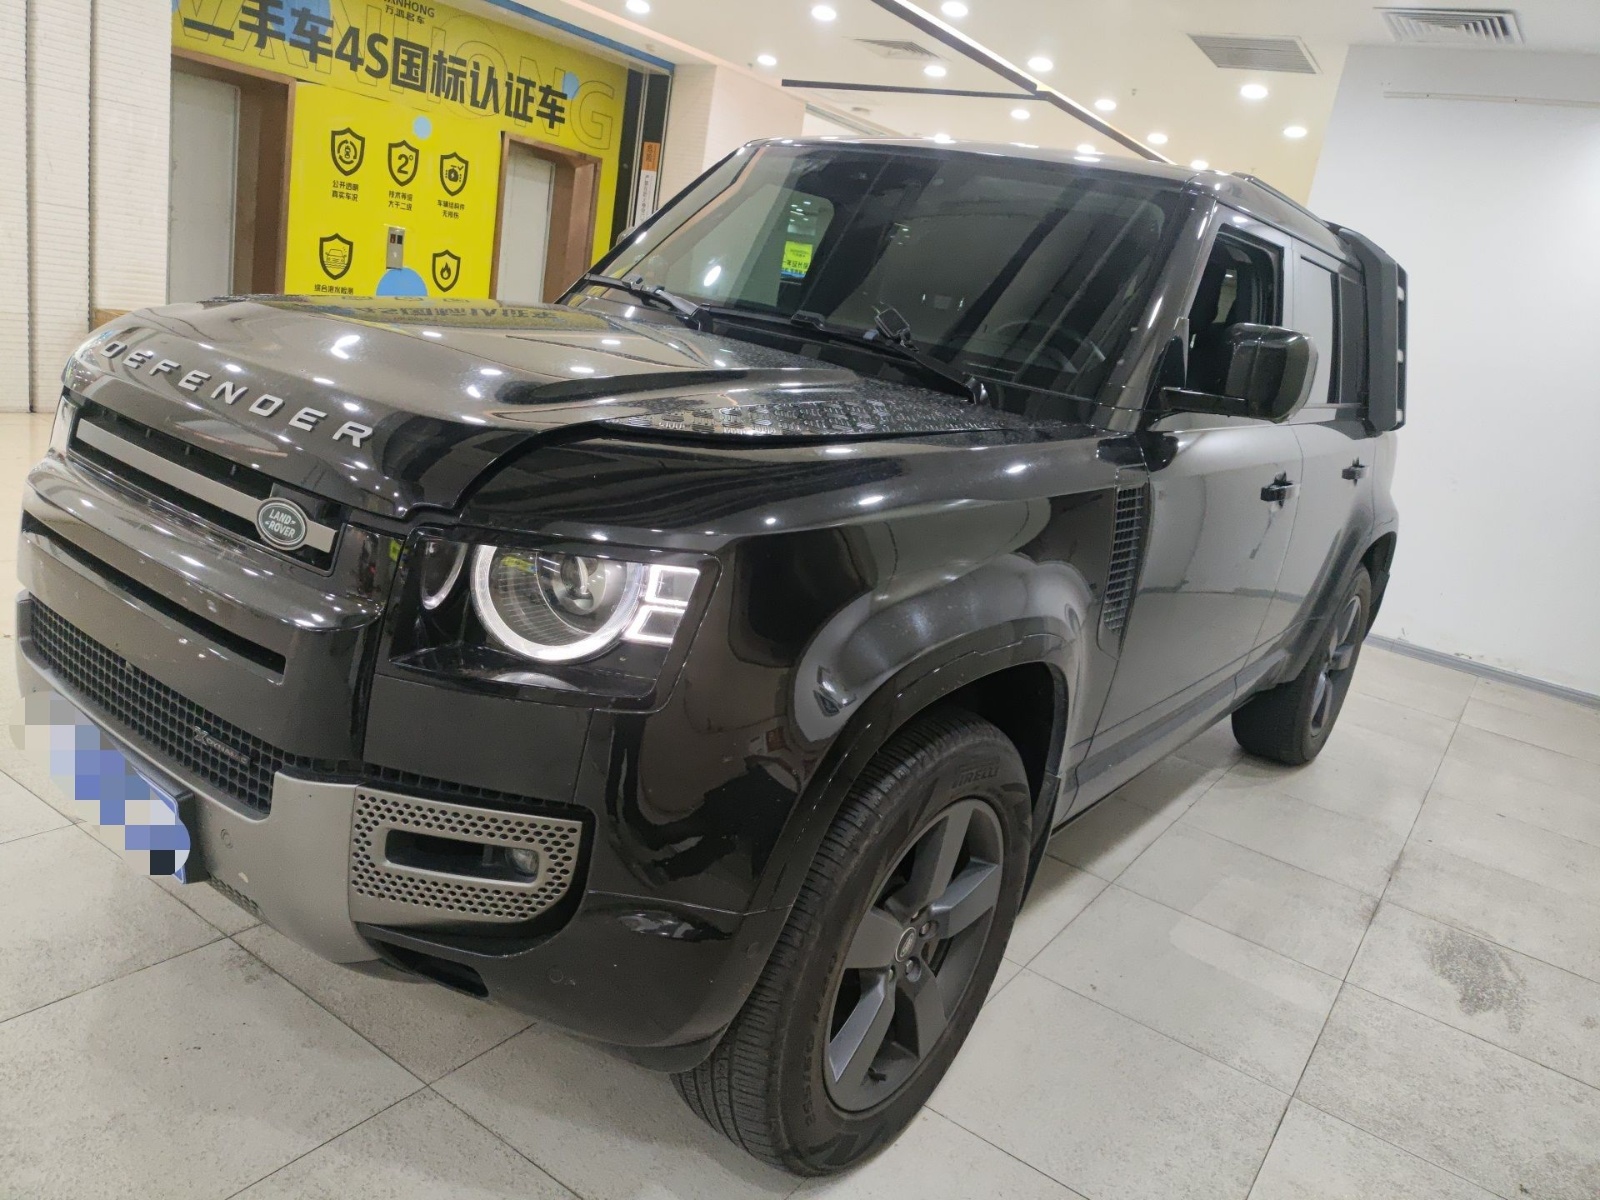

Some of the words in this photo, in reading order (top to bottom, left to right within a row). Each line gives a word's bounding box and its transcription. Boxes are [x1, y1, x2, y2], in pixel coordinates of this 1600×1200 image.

[100, 340, 374, 449] DEFENDER
[268, 508, 292, 525] LAND
[268, 520, 296, 538] ROVER
